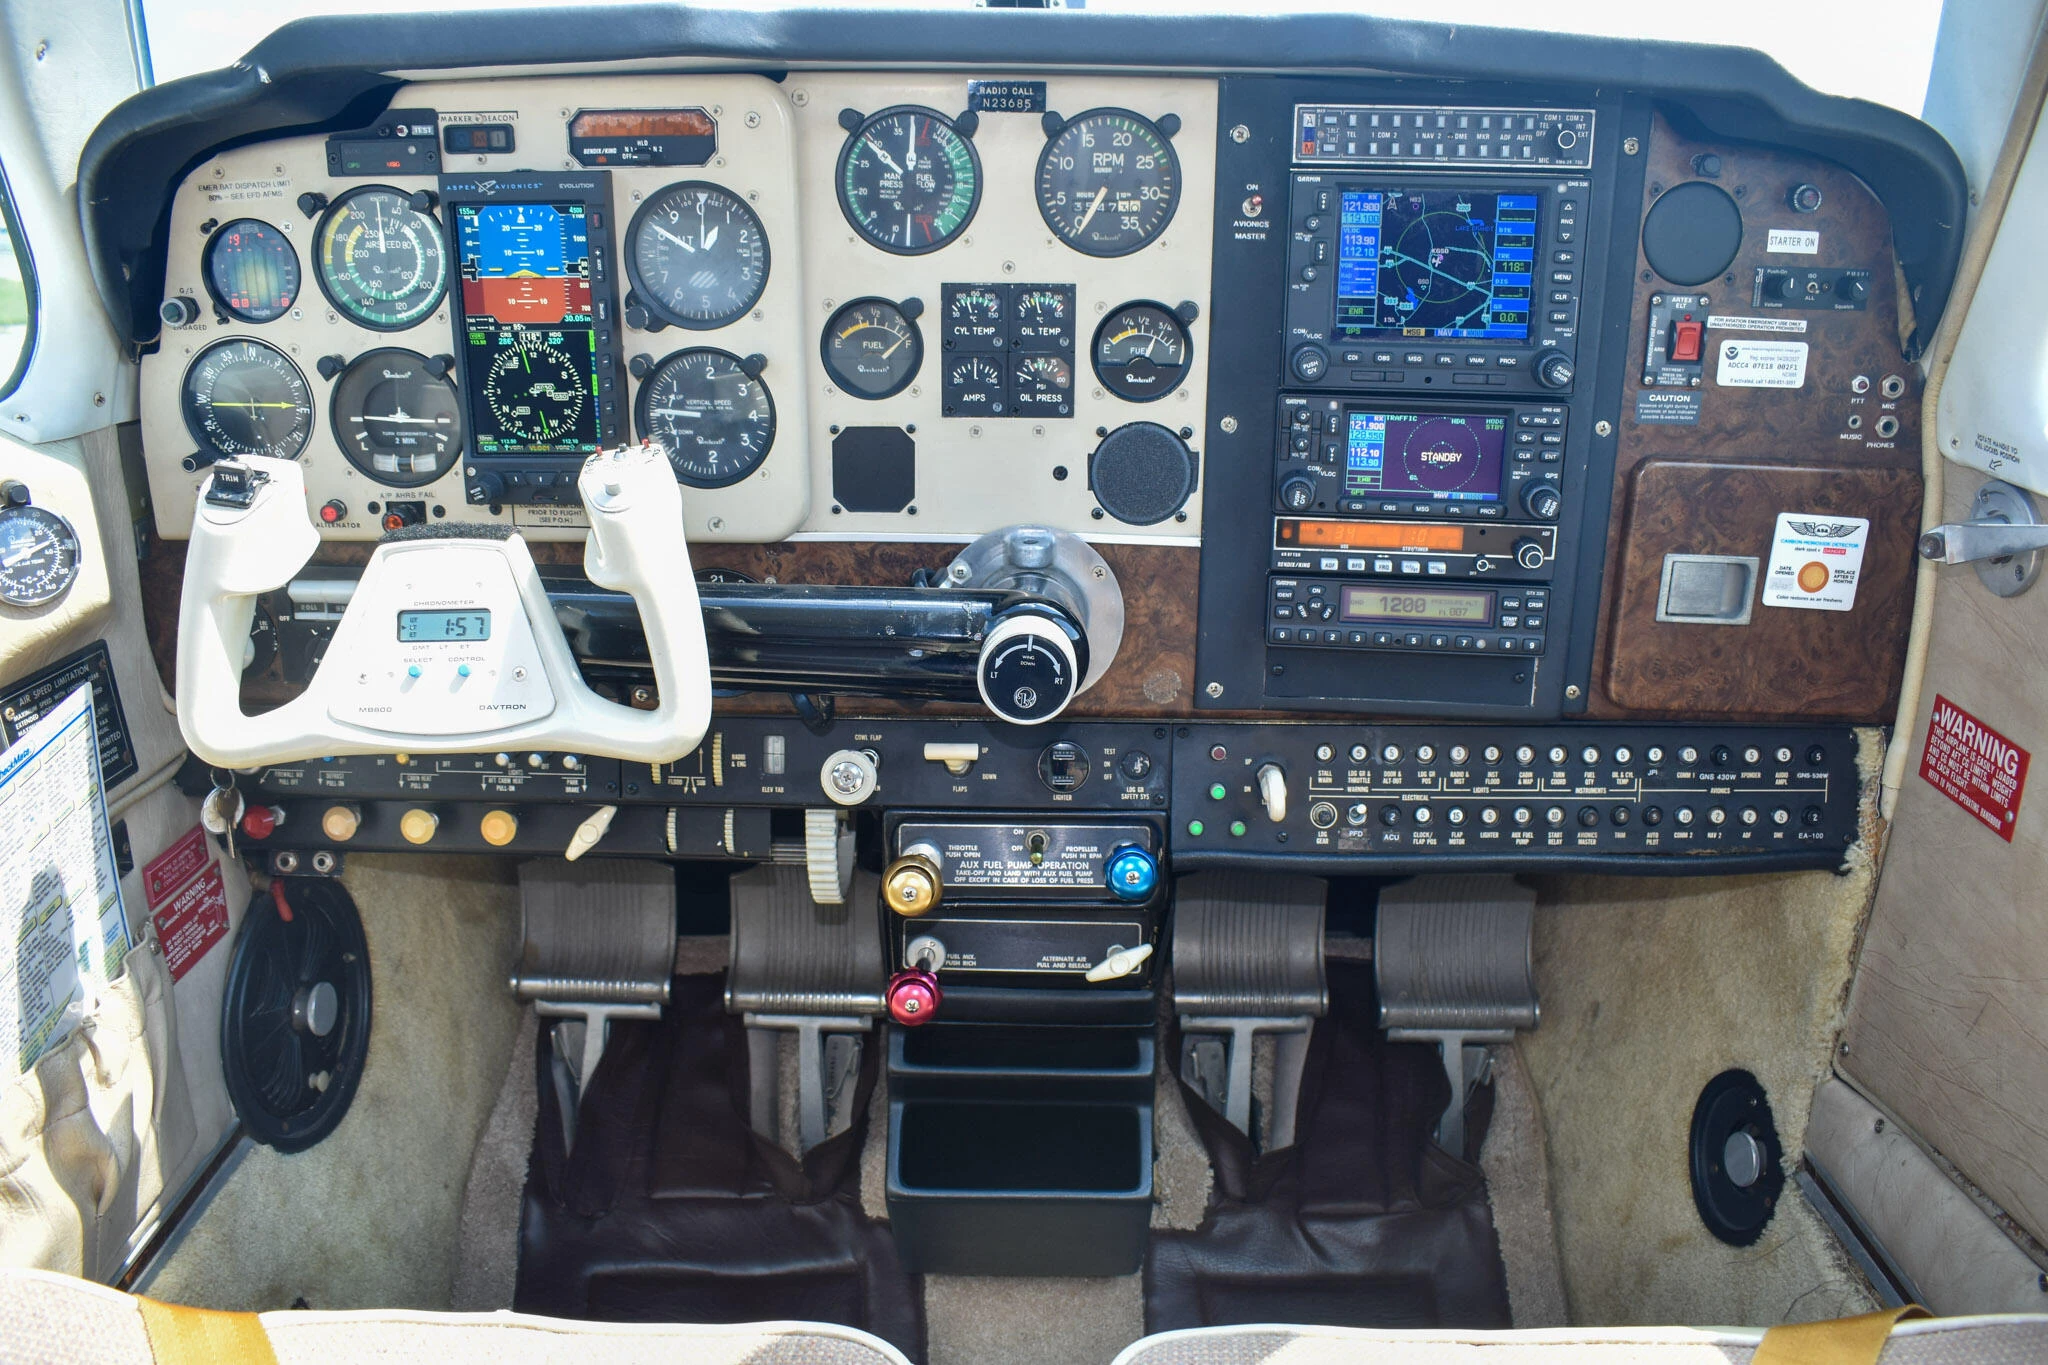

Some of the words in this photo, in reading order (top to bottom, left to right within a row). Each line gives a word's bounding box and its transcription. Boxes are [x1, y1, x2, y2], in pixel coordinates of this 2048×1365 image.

[979, 87, 1008, 95] RADIO
[1012, 87, 1035, 95] CALL
[982, 98, 1032, 109] N23685
[1082, 134, 1095, 147] 15
[1112, 132, 1133, 146] 20
[1454, 132, 1468, 140] DME
[1059, 156, 1074, 170] 10
[1093, 152, 1124, 167] RPM
[1136, 155, 1154, 169] 25
[884, 172, 901, 180] MAN
[916, 174, 933, 182] FUEL
[235, 181, 271, 190] DISPATCH
[879, 180, 903, 189] PRESS
[1140, 186, 1160, 200] 30
[1344, 200, 1380, 211] 121.900
[1121, 216, 1139, 230] 35
[365, 240, 401, 249] AIRSEED
[1344, 235, 1375, 246] 113.90
[1769, 235, 1801, 247] STARTER
[1804, 237, 1816, 247] ON
[1343, 247, 1375, 257] 112.10
[1554, 273, 1571, 281] MENU
[564, 315, 584, 323] 30.05
[953, 326, 970, 335] CYL
[972, 326, 996, 335] TEMP
[1021, 327, 1035, 336] OIL
[1039, 327, 1061, 336] TEMP
[862, 341, 885, 350] FUEL
[962, 393, 986, 402] AMPS
[1020, 393, 1033, 402] OIL
[1036, 394, 1063, 403] PRESS
[1649, 394, 1691, 403] CAUTION
[1350, 420, 1385, 431] 121.900
[1840, 433, 1863, 441] MUSIC
[1350, 448, 1380, 457] 112.10
[1420, 451, 1462, 463] STANDBY
[1350, 457, 1379, 467] 113.90
[219, 473, 239, 483] TRIM
[413, 599, 475, 607] CHRONOMETER
[1379, 596, 1426, 614] 1200
[445, 616, 485, 637] 1:57
[990, 671, 998, 679] LT
[19, 694, 32, 706] AIR
[32, 683, 53, 700] SPEED
[53, 664, 90, 689] LIMITATION
[1054, 677, 1064, 685] RT
[479, 703, 527, 711] DAVTRON
[1940, 703, 2019, 777] WARNING
[1933, 724, 1945, 740] THIS
[1945, 733, 1970, 757] AIRPLANE
[1970, 750, 1977, 762] IS
[1977, 755, 1996, 773] EASILY
[1995, 767, 2018, 790] LOADED
[1926, 753, 1936, 768] FOR
[1936, 762, 1950, 776] EACH
[1931, 734, 1951, 755] BEYOND
[1951, 747, 1962, 761] AFT
[1961, 755, 1970, 768] CG
[1991, 777, 2014, 799] WEIGHT
[1928, 744, 1940, 758] AND
[1940, 752, 1948, 764] CG
[1948, 758, 1964, 774] MUST
[1964, 769, 1971, 781] BE
[1971, 773, 1991, 795] WITHIN
[1990, 787, 2009, 809] LIMITS
[1979, 807, 2003, 830] HANDBOOK
[959, 860, 980, 869] AUX
[983, 861, 1004, 870] FUEL
[1007, 861, 1033, 870] PUMP
[1037, 861, 1090, 870] OPERATION
[172, 877, 207, 912] WARNING
[1041, 955, 1074, 963] ALTERNATE
